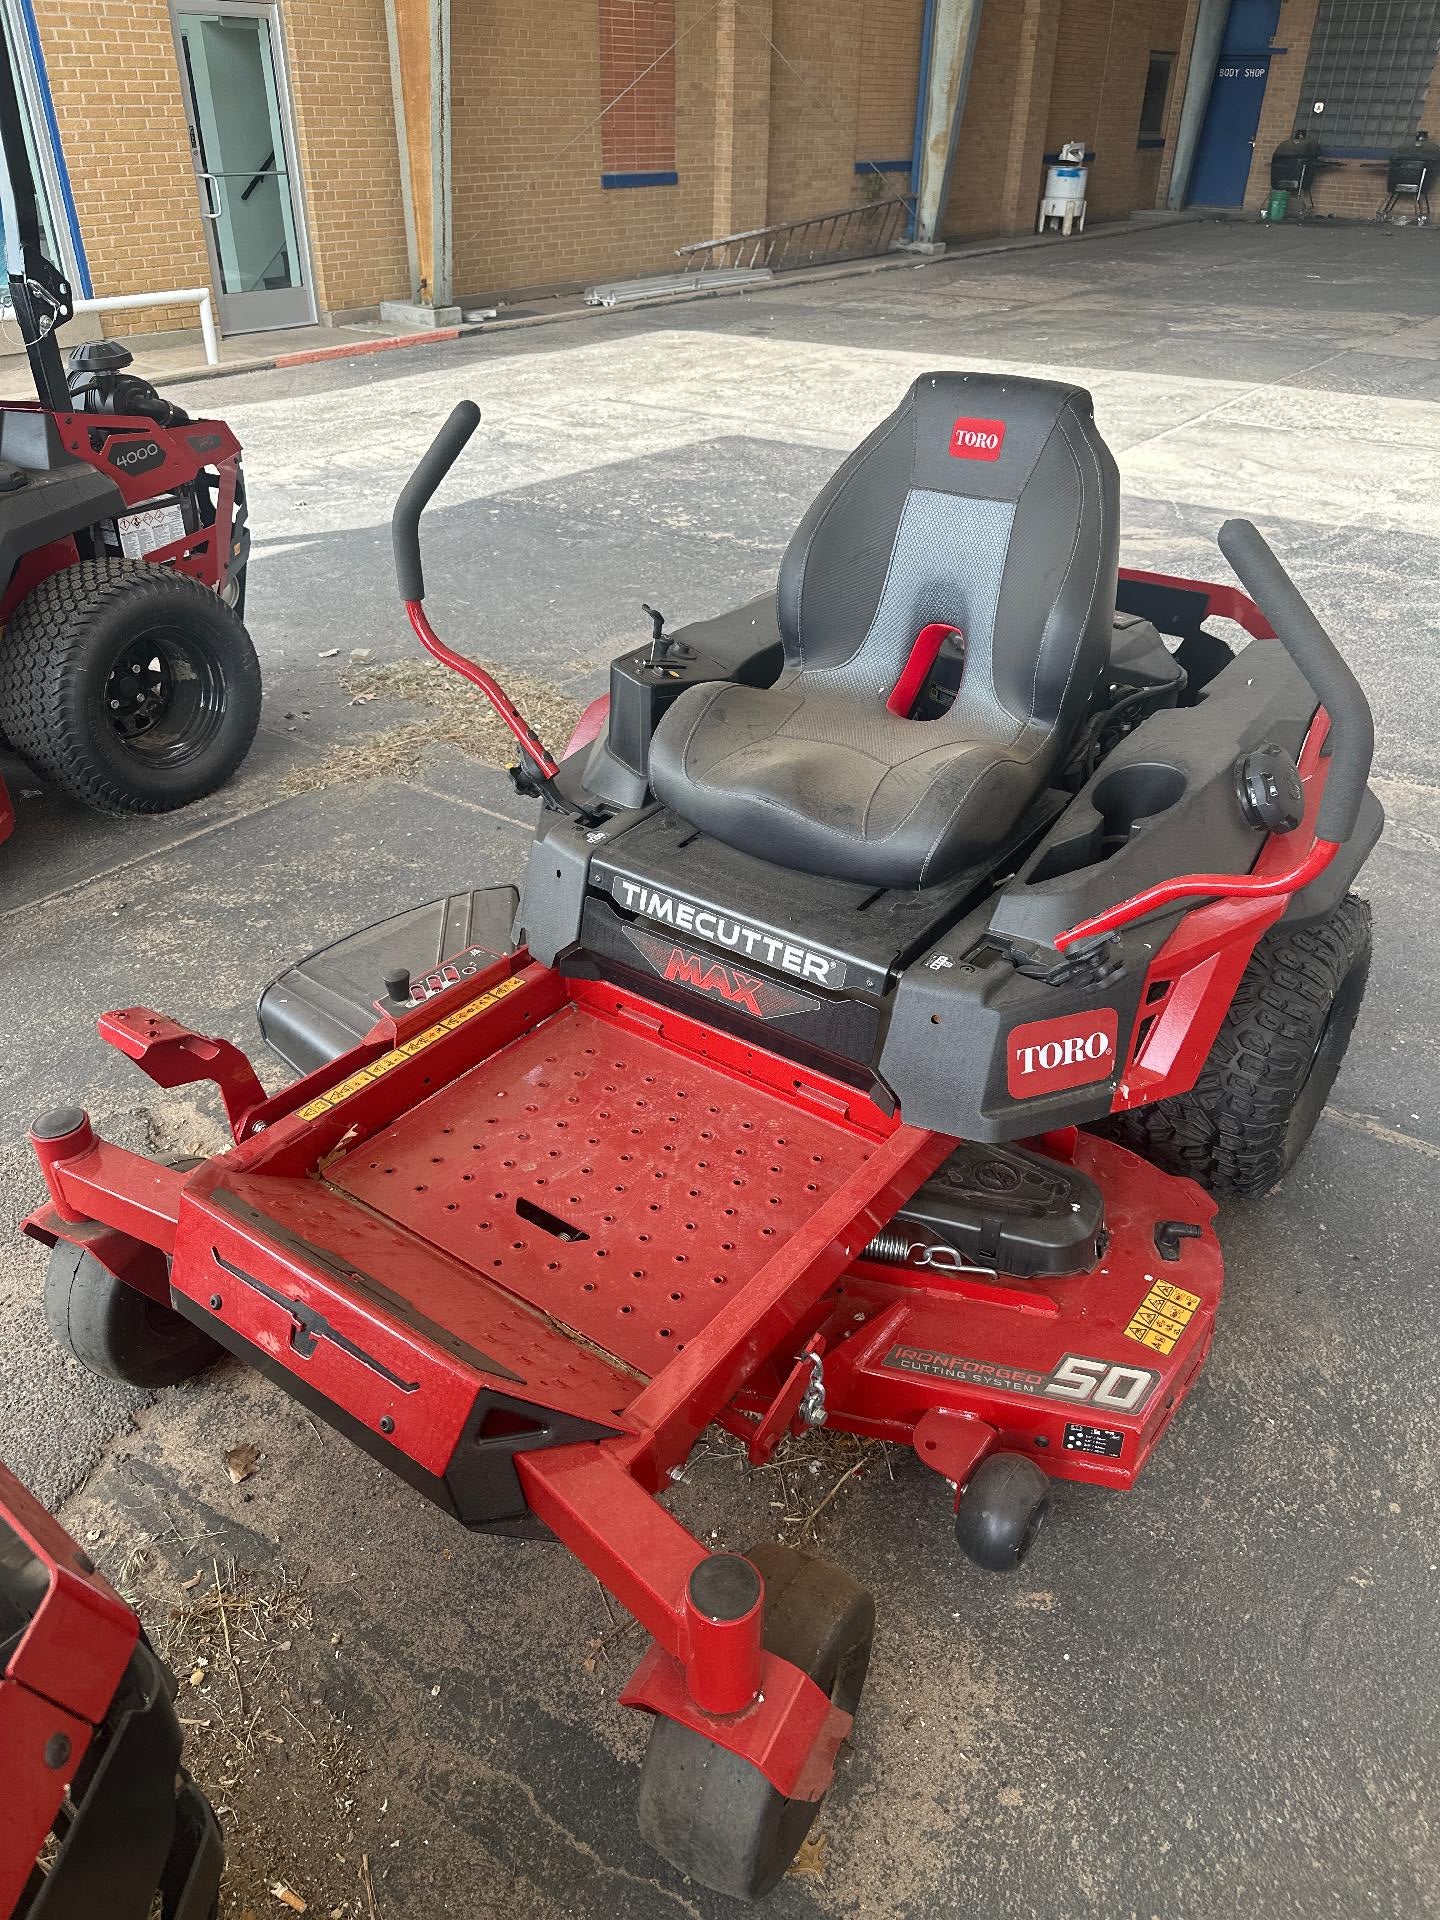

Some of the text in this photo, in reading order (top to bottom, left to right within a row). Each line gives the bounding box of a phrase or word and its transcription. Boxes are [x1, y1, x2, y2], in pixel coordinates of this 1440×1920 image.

[1219, 68, 1265, 78] BODY SHOP
[116, 443, 158, 467] 4000
[955, 429, 999, 450] TORO
[663, 947, 765, 1017] MAX
[895, 1347, 1042, 1385] IRONFORGED
[900, 1359, 1034, 1393] CUTTING SYSTEM
[1044, 1356, 1152, 1409] 50
